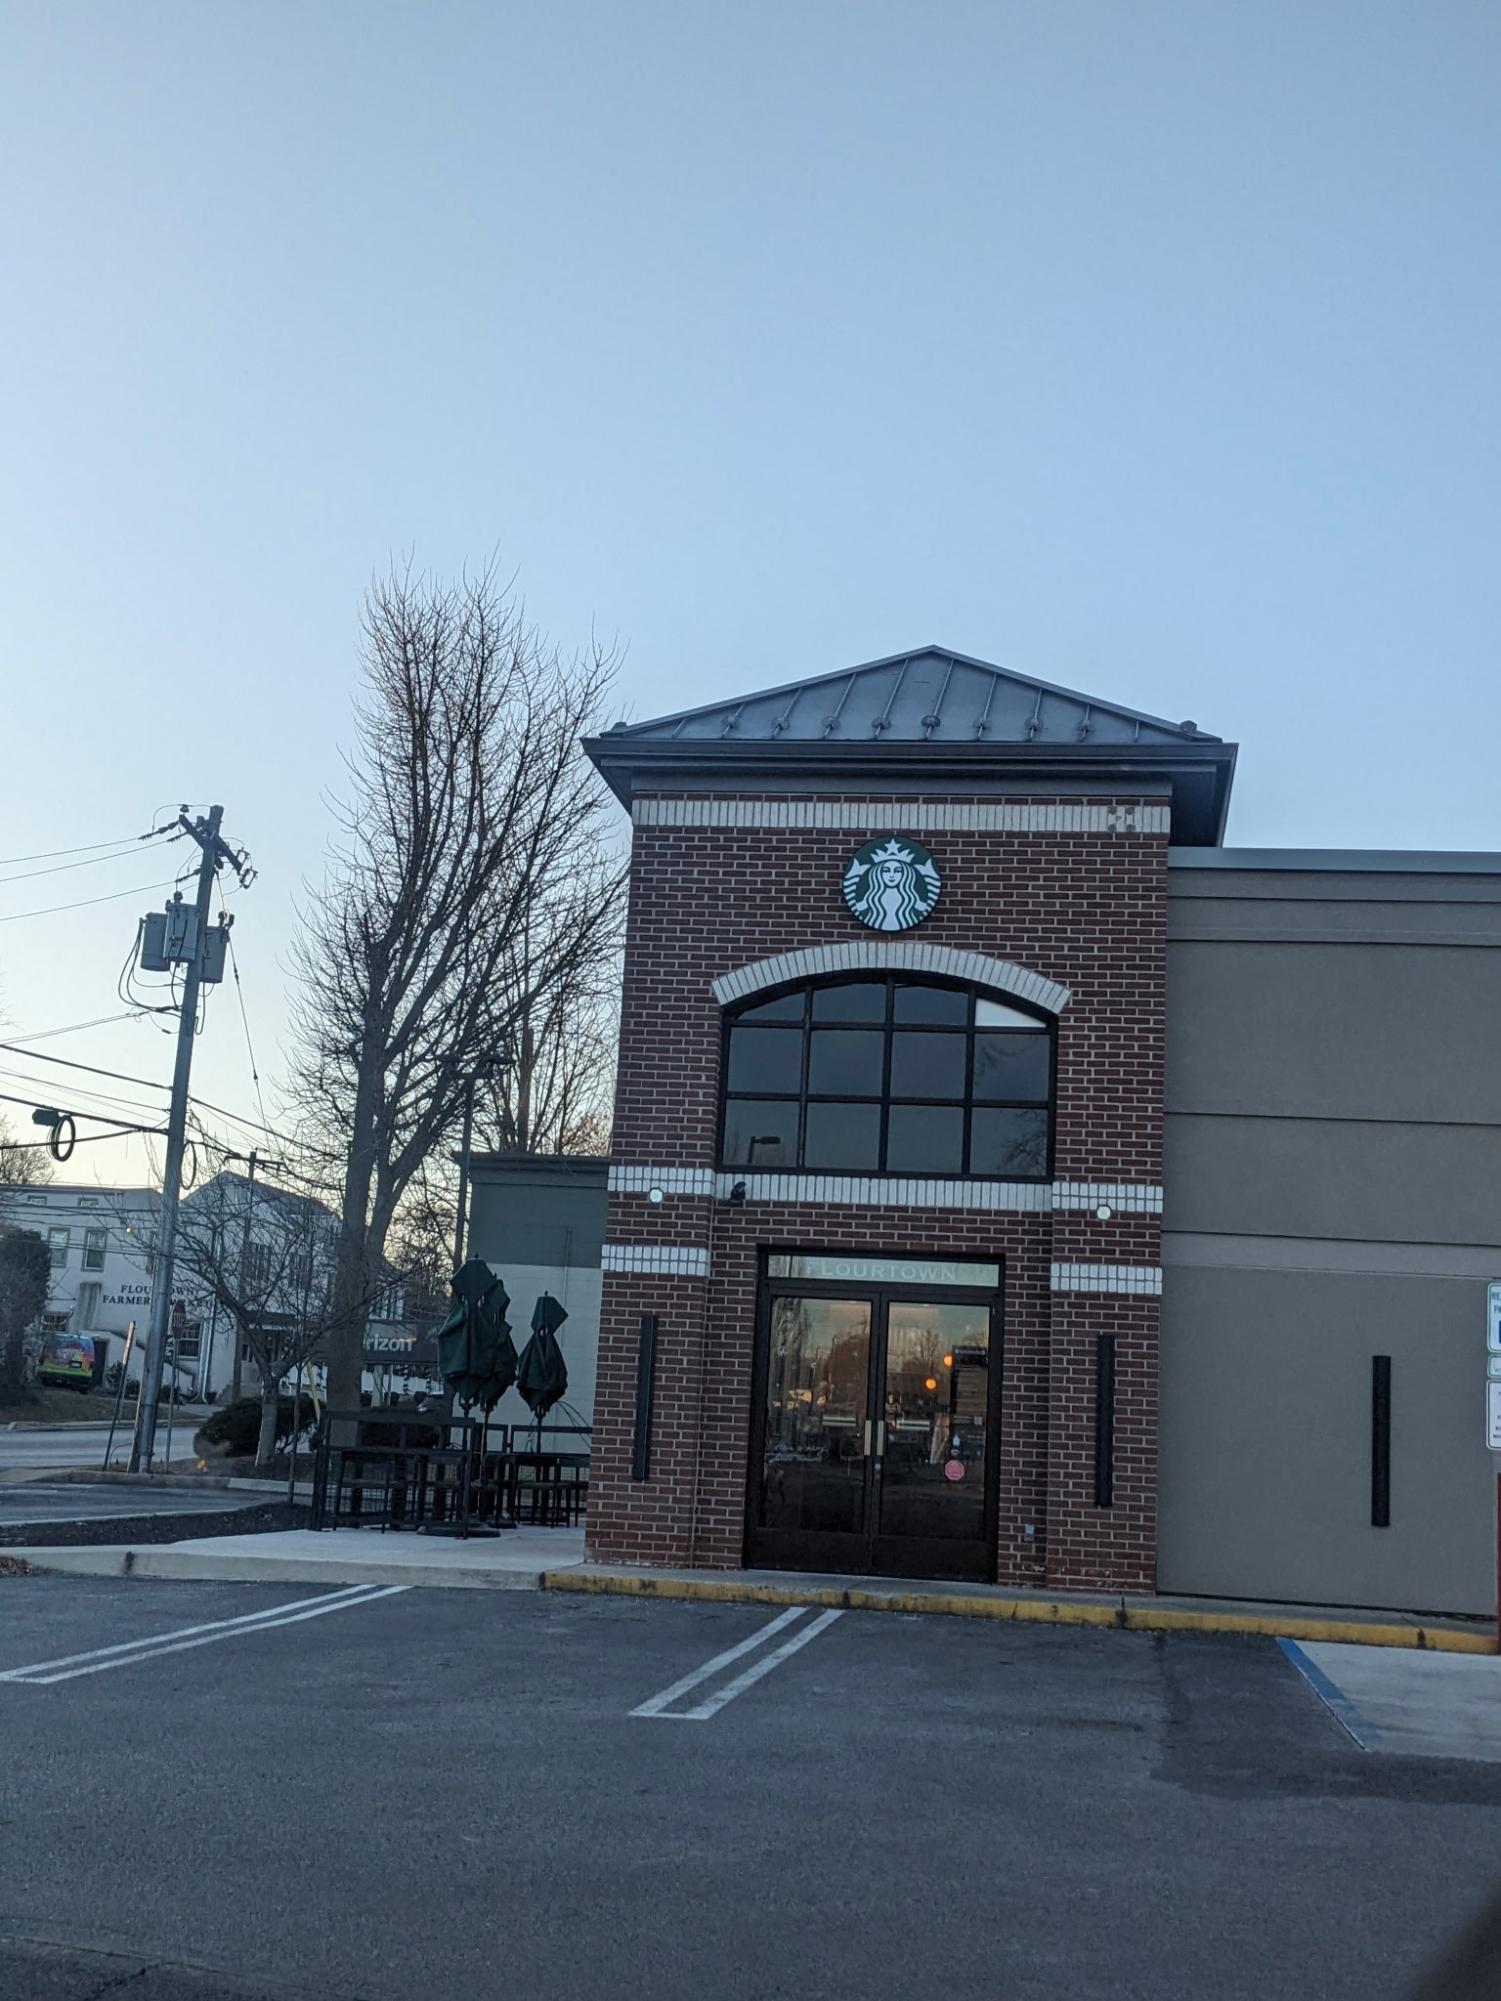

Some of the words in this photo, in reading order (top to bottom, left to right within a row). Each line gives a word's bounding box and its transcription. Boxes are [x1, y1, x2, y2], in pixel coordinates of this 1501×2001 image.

[807, 1261, 956, 1281] FLOURTOWN
[102, 1295, 151, 1305] FARMER
[363, 1333, 416, 1352] rizon
